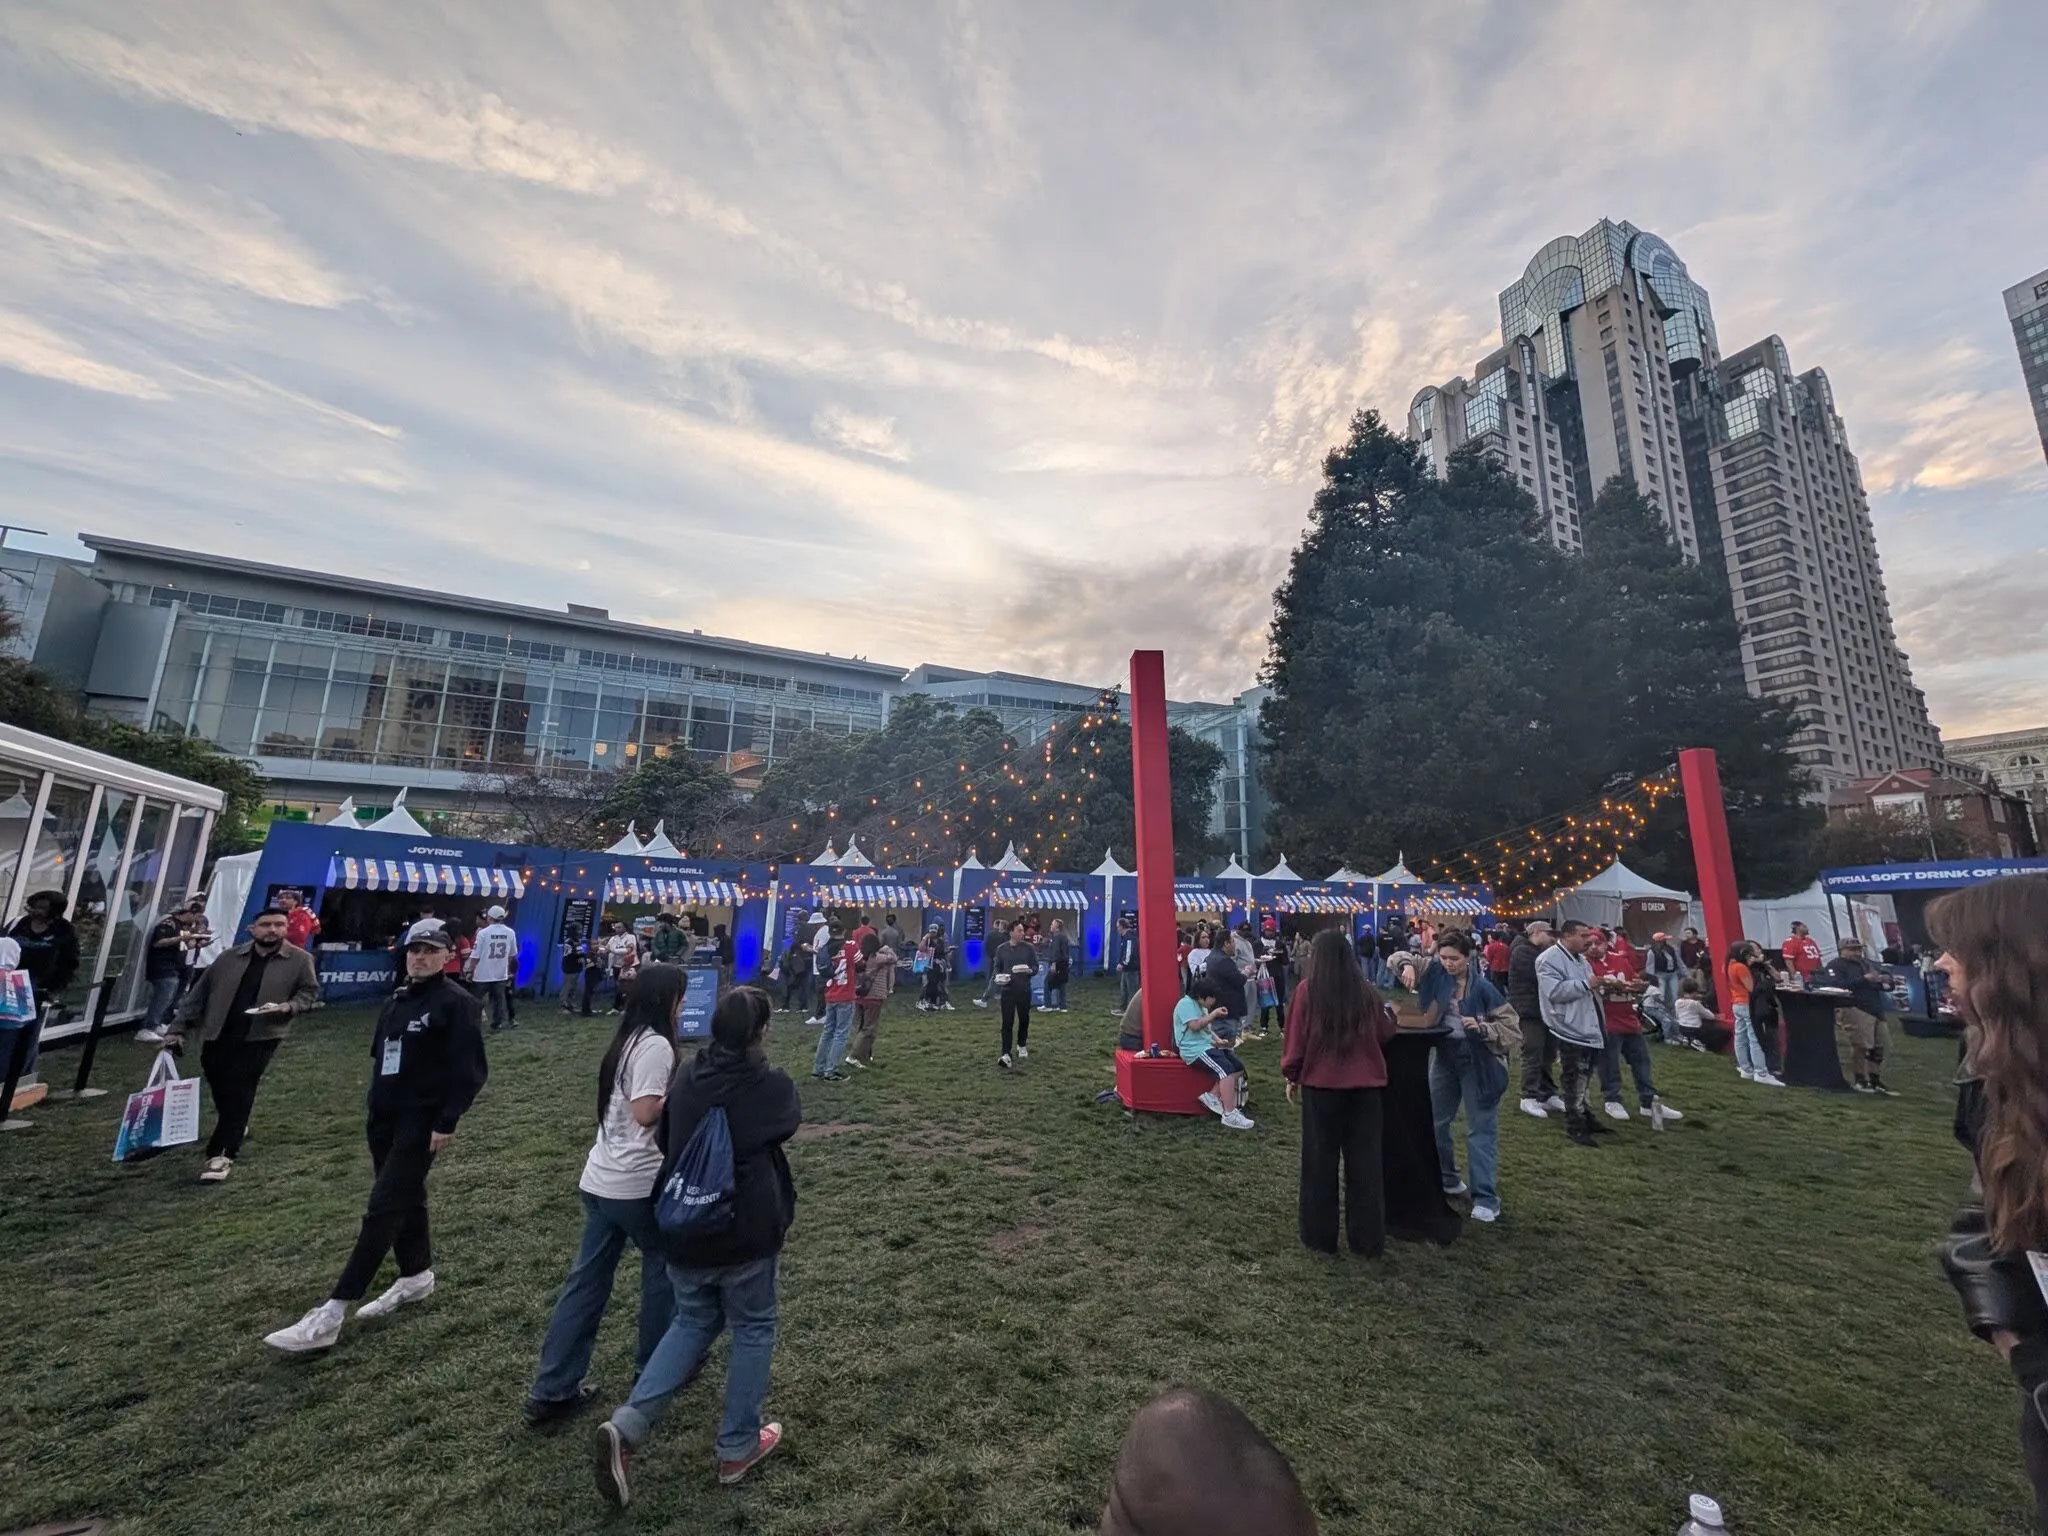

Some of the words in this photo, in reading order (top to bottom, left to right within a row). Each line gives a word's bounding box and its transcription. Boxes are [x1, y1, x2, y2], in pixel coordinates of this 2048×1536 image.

[407, 846, 464, 858] JOYRIDE
[649, 866, 678, 874] OASIS
[678, 867, 704, 875] GRILL
[1828, 874, 1870, 885] OFFICIAL
[1870, 871, 1912, 882] SOFT
[1914, 869, 1970, 880] DRINK
[1972, 868, 1998, 877] OF
[488, 942, 507, 959] 13
[1803, 945, 1820, 959] 53
[319, 970, 356, 983] THE
[355, 970, 391, 982] BAY
